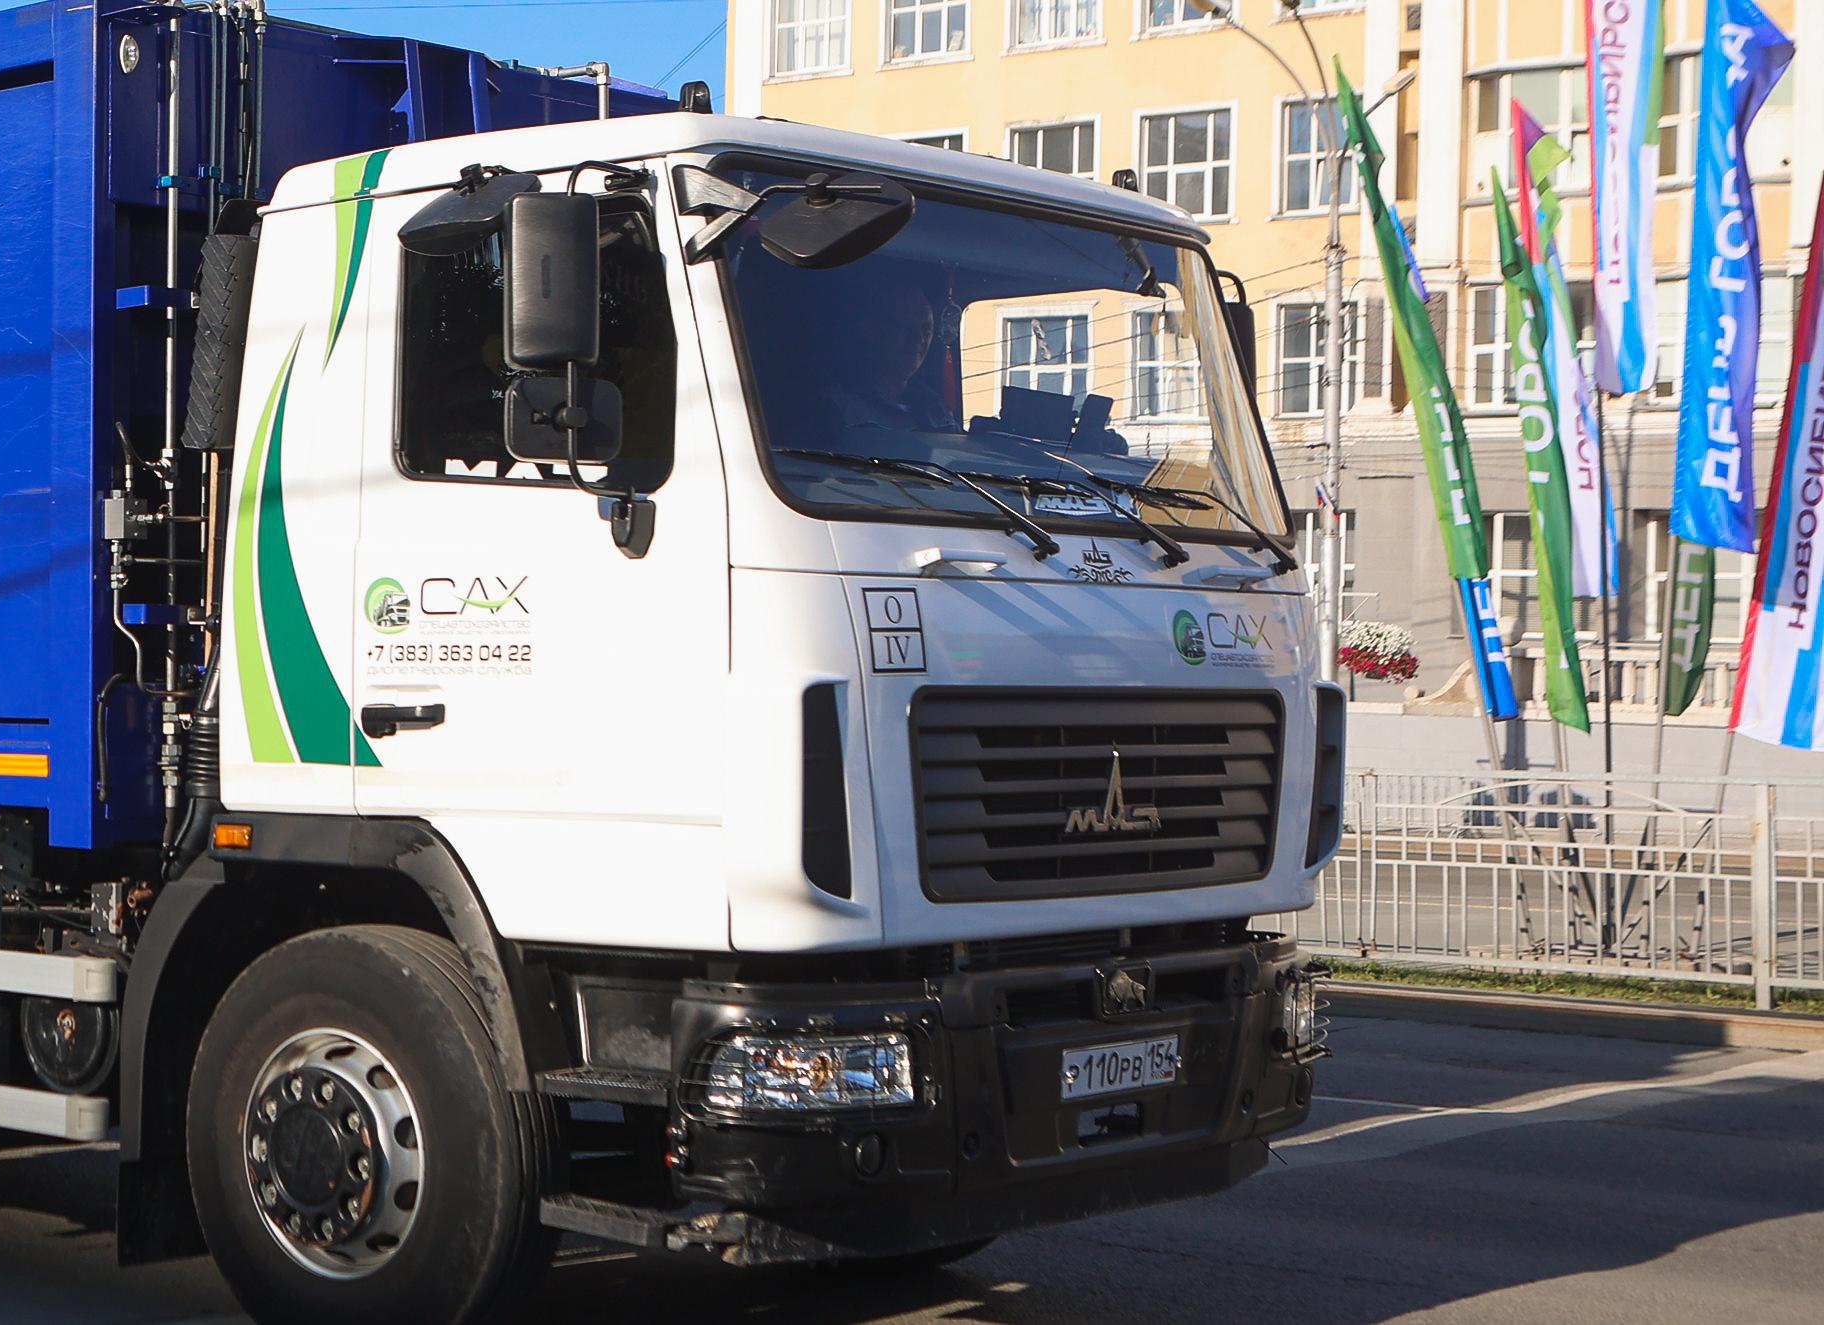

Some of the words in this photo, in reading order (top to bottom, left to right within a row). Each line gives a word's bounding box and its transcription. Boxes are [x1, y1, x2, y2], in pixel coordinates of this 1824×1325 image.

[421, 575, 529, 615] САХ
[1207, 612, 1273, 650] САХ
[368, 645, 384, 662] +7
[389, 644, 433, 664] (383)
[439, 645, 473, 662] 363
[479, 645, 502, 662] 04
[508, 645, 532, 662] 22
[884, 635, 911, 665] IV
[1148, 1040, 1177, 1069] 154
